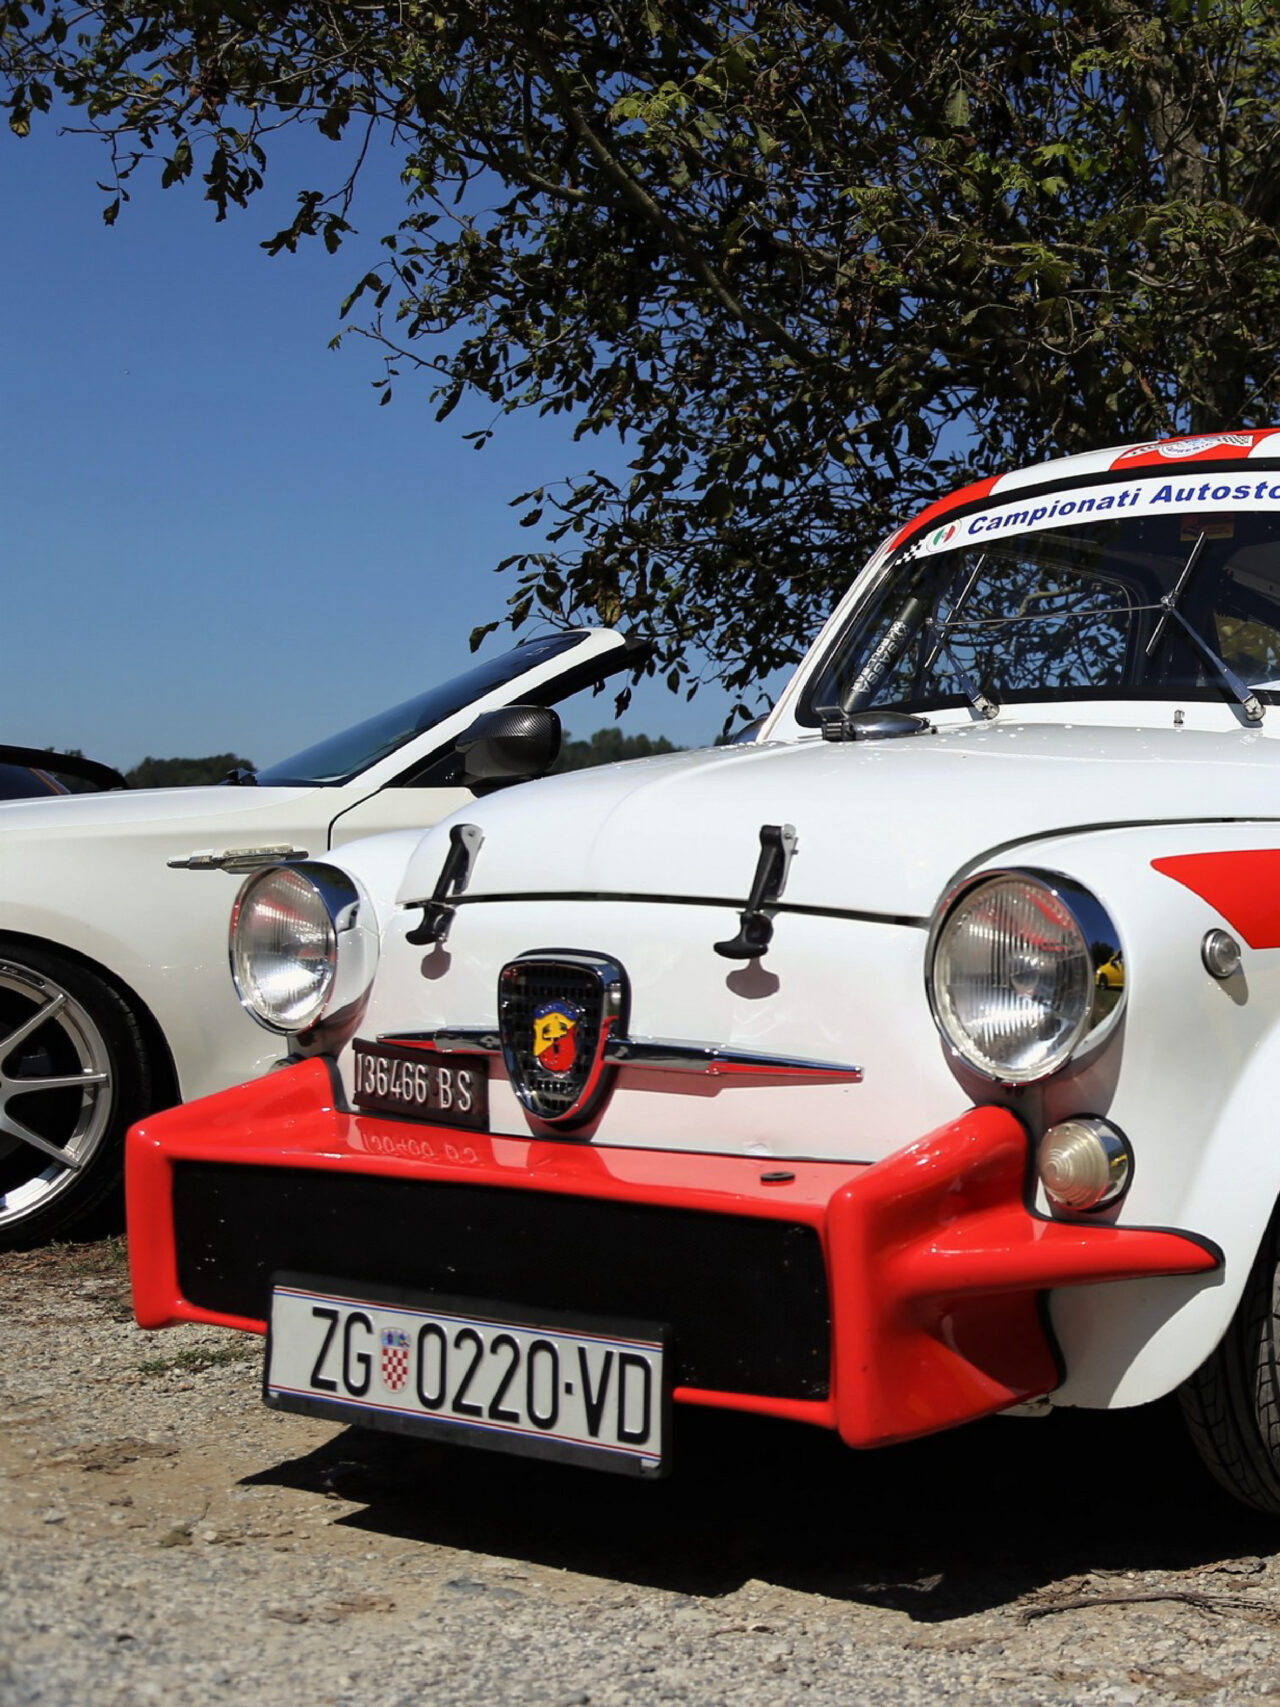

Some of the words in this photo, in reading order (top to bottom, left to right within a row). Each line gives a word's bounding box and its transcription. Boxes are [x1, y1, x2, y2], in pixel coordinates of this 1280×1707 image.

[967, 488, 1142, 536] Campionati
[860, 643, 899, 693] SASSA
[355, 1051, 428, 1105] 136466
[309, 1306, 375, 1398] ZG
